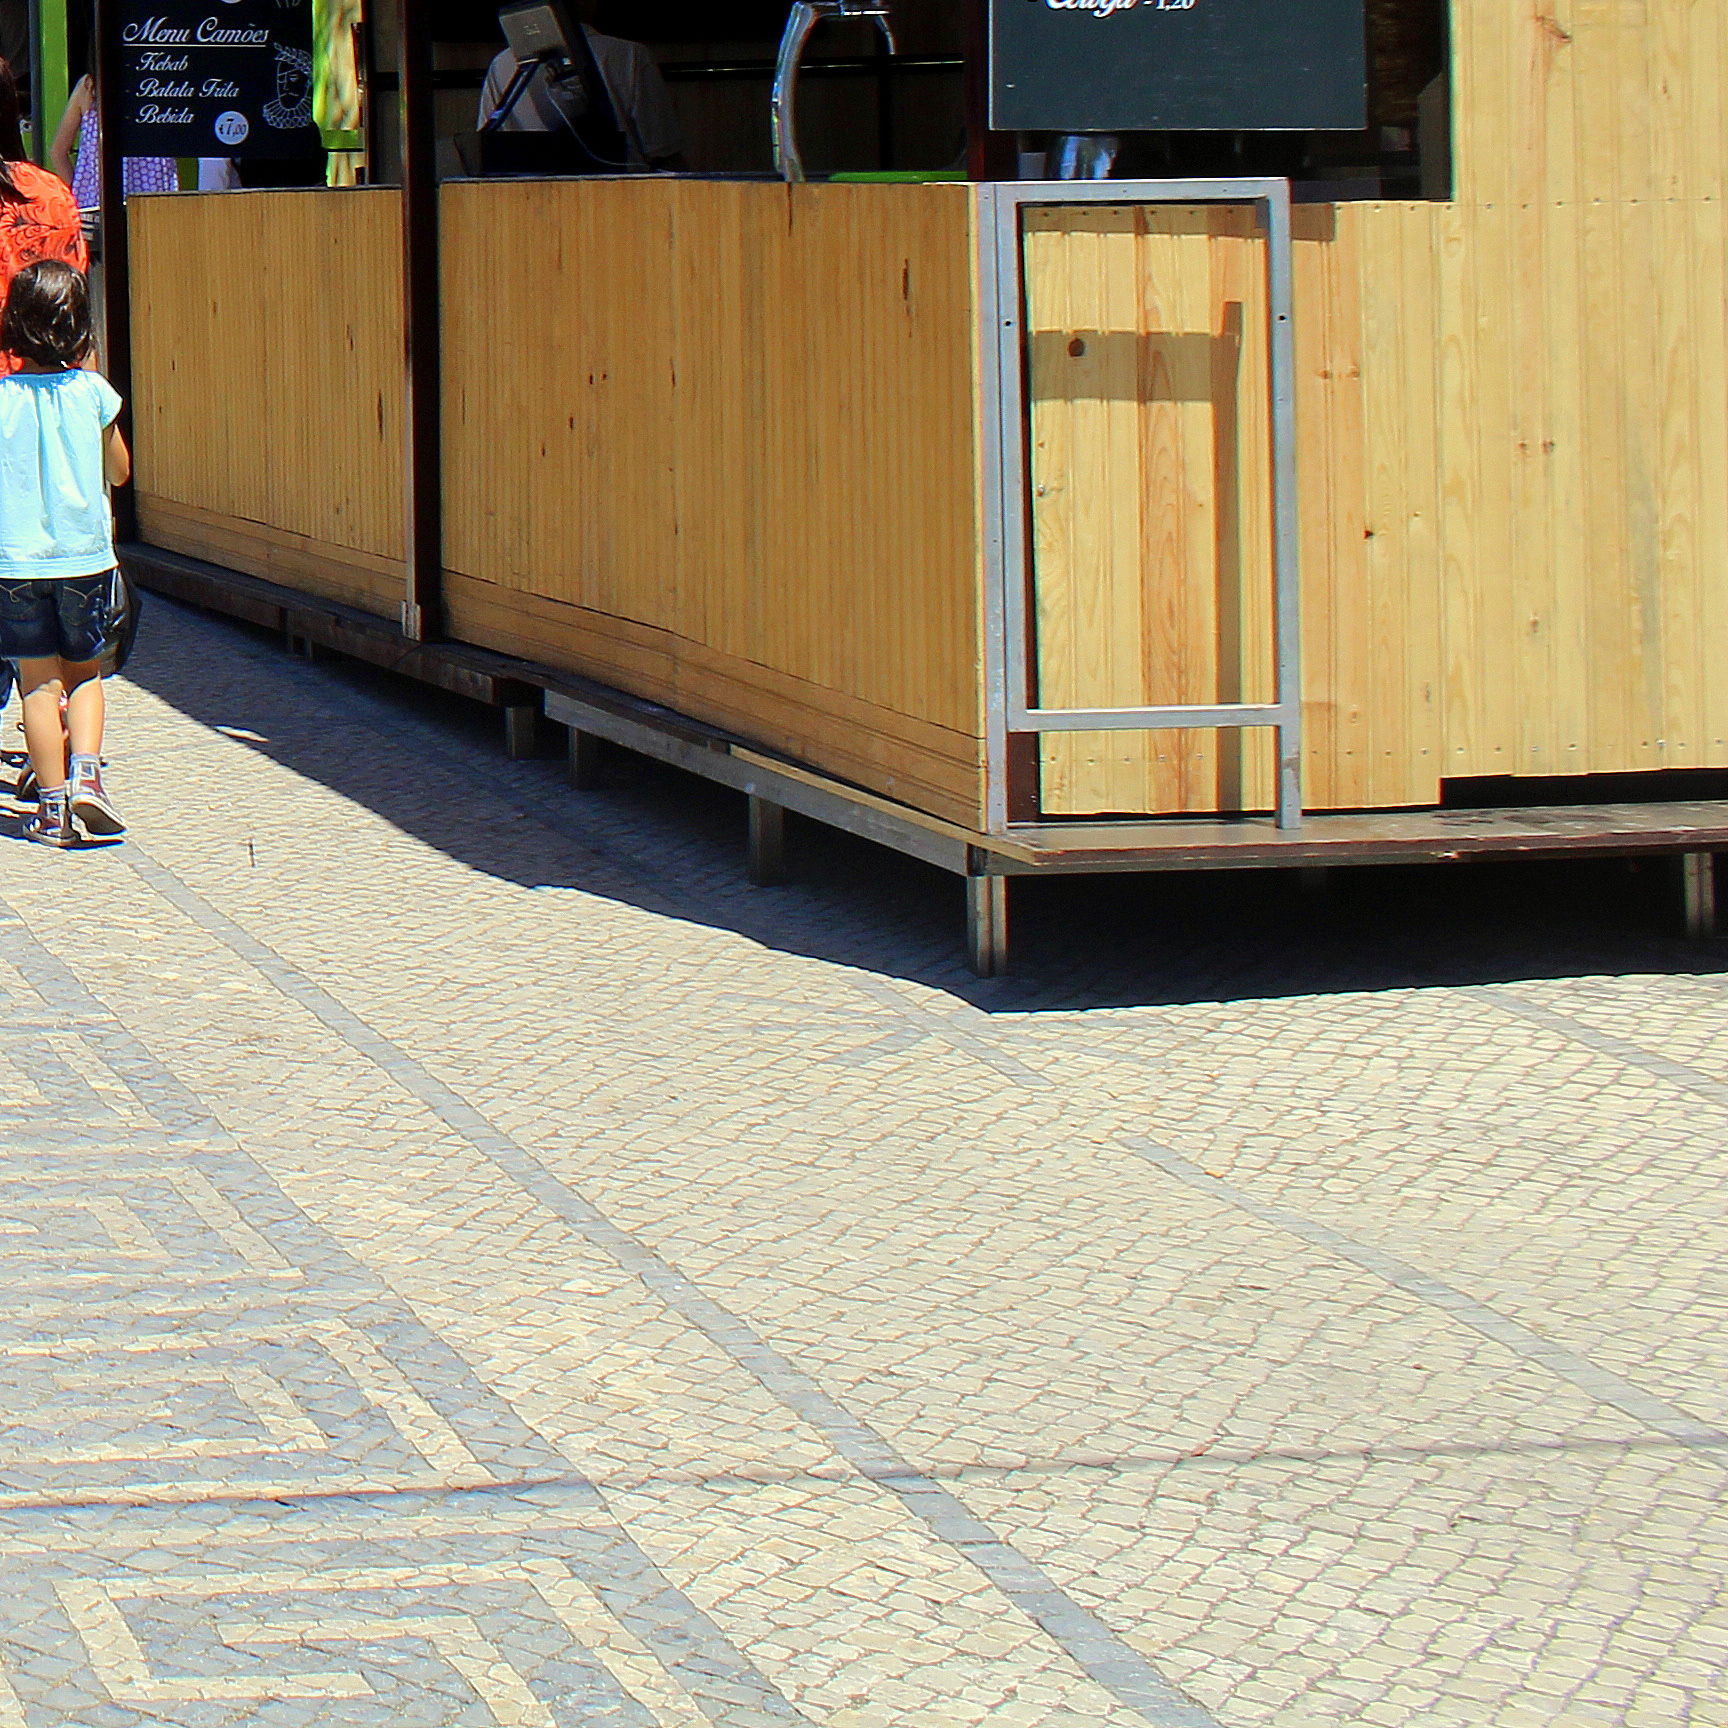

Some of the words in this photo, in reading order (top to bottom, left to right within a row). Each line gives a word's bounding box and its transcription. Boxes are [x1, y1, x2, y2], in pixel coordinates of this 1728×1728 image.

[122, 16, 191, 43] Menu
[196, 16, 270, 44] Camões
[136, 52, 189, 71] Kebab
[136, 78, 194, 98] Batata
[198, 78, 240, 98] Frita
[136, 104, 194, 124] Bebida
